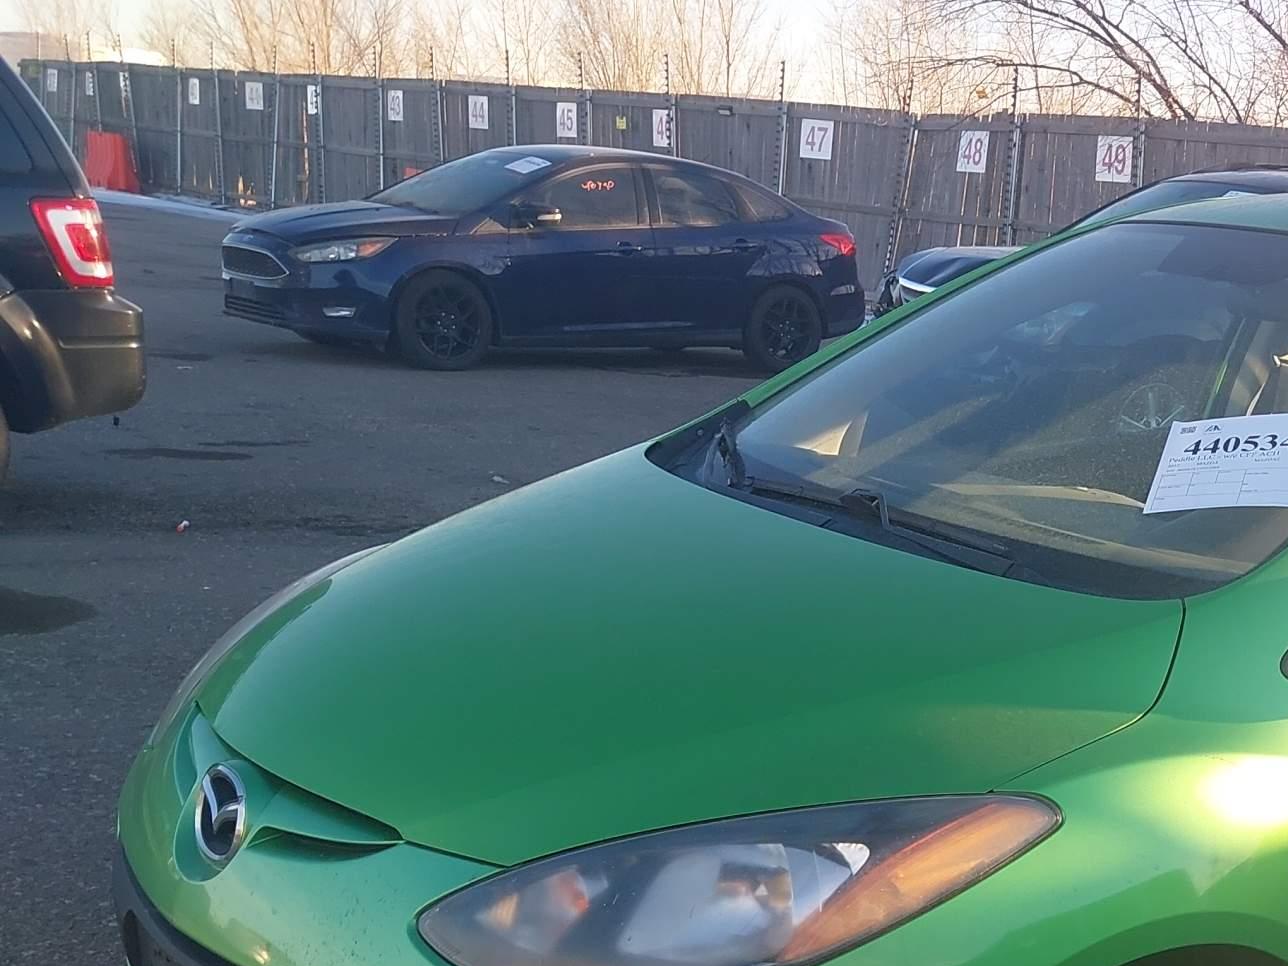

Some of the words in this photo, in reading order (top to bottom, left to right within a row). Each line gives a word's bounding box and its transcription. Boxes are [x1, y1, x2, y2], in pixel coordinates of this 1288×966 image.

[471, 100, 485, 123] 44
[560, 108, 573, 131] 45
[805, 125, 828, 152] 47
[962, 137, 984, 167] 48
[1102, 143, 1126, 175] 49
